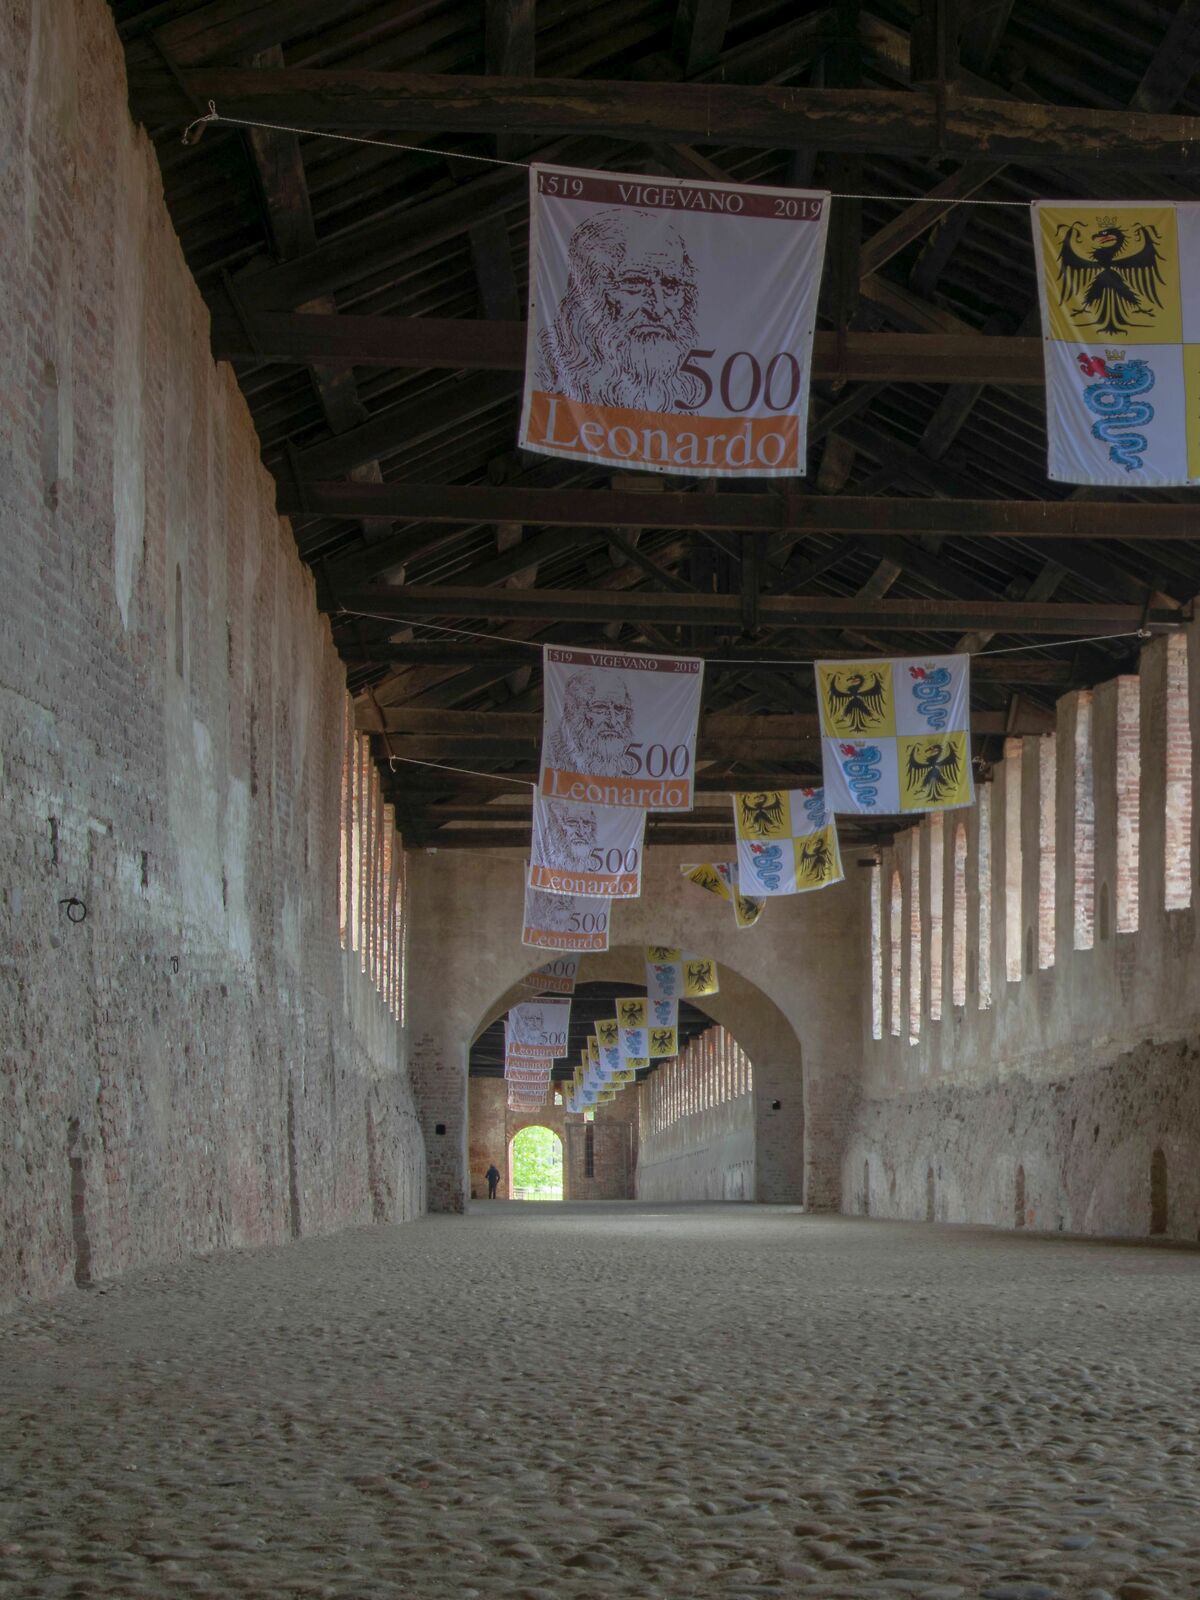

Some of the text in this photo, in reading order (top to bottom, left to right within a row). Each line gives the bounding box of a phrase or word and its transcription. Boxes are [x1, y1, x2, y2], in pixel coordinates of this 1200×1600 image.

[538, 174, 822, 218] 1519 VIGEVANO 2019
[674, 349, 800, 413] 500
[541, 397, 786, 466] Leonardo
[548, 650, 700, 673] 1519 VIGEVANO 2019
[621, 743, 690, 778] 500
[550, 768, 683, 807] Leonardo
[587, 848, 638, 873] 500
[536, 867, 633, 894] Leonardo
[567, 912, 608, 933] 500
[527, 928, 604, 949] Leonardo
[511, 1044, 564, 1057] Leonardo
[540, 1032, 566, 1046] 500
